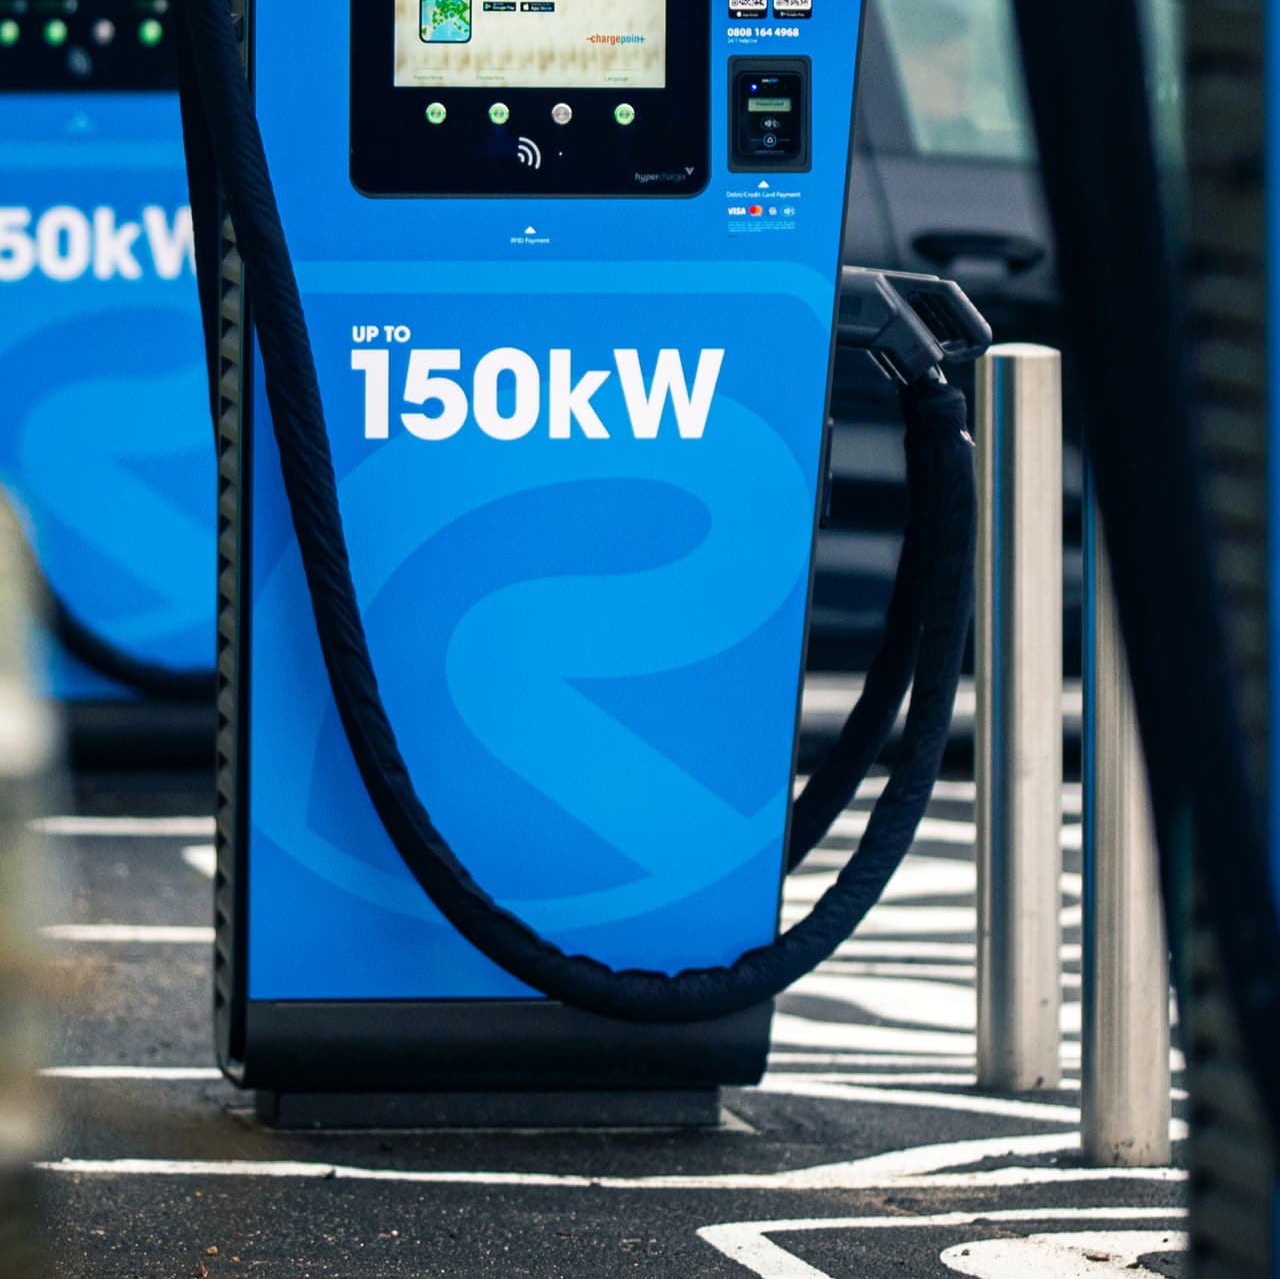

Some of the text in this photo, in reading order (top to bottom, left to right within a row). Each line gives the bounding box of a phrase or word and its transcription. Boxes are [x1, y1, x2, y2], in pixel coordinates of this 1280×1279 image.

[727, 28, 799, 37] 0808 164 4968
[728, 207, 746, 215] VISA
[352, 325, 411, 343] UP TO
[351, 347, 725, 441] 150kW
